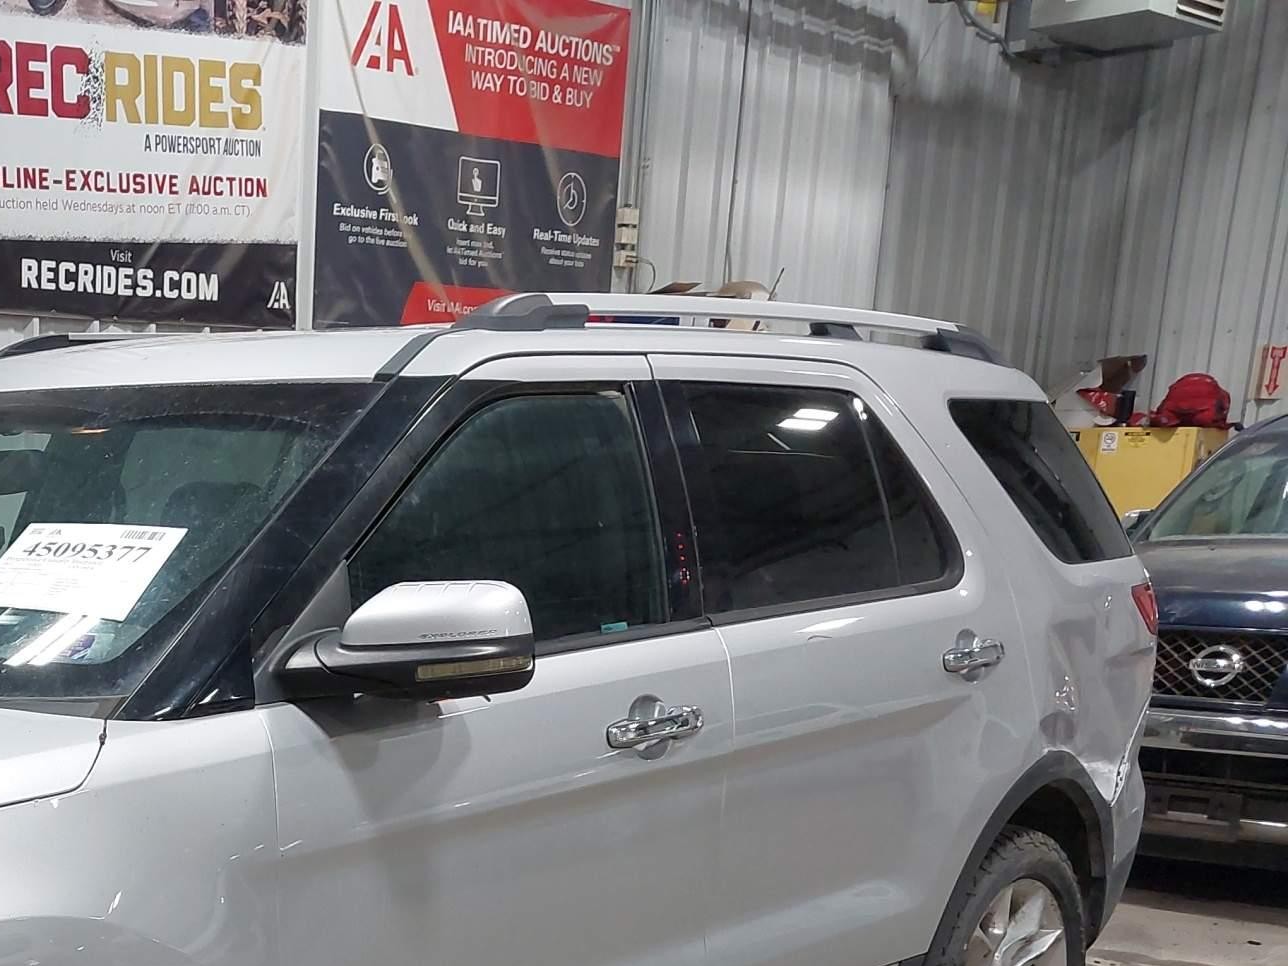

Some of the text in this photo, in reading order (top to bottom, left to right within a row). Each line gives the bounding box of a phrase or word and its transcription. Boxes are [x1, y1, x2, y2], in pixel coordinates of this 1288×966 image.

[448, 10, 474, 38] IAA
[476, 18, 532, 49] TIMED
[464, 43, 604, 87] INTRODUCING A NEW
[104, 50, 263, 131] RIDES
[471, 70, 593, 109] WAY TO BID & BUY
[144, 133, 262, 158] A POWERSPORT AUCTION
[188, 174, 268, 198] AUCTION
[35, 198, 59, 211] held
[62, 199, 124, 215] Wednesdays
[125, 203, 136, 214] at
[139, 204, 164, 215] noon
[168, 203, 182, 214] ET
[212, 205, 232, 216] a.m.
[333, 203, 419, 226] Exclusive Firs ook
[357, 235, 365, 243] to
[447, 218, 507, 239] Quick and Easy
[533, 228, 572, 243] Real-Time
[110, 249, 133, 264] Visit
[20, 257, 219, 301] RECRIDES.COM
[426, 298, 446, 313] Visit
[22, 541, 153, 563] 45095377
